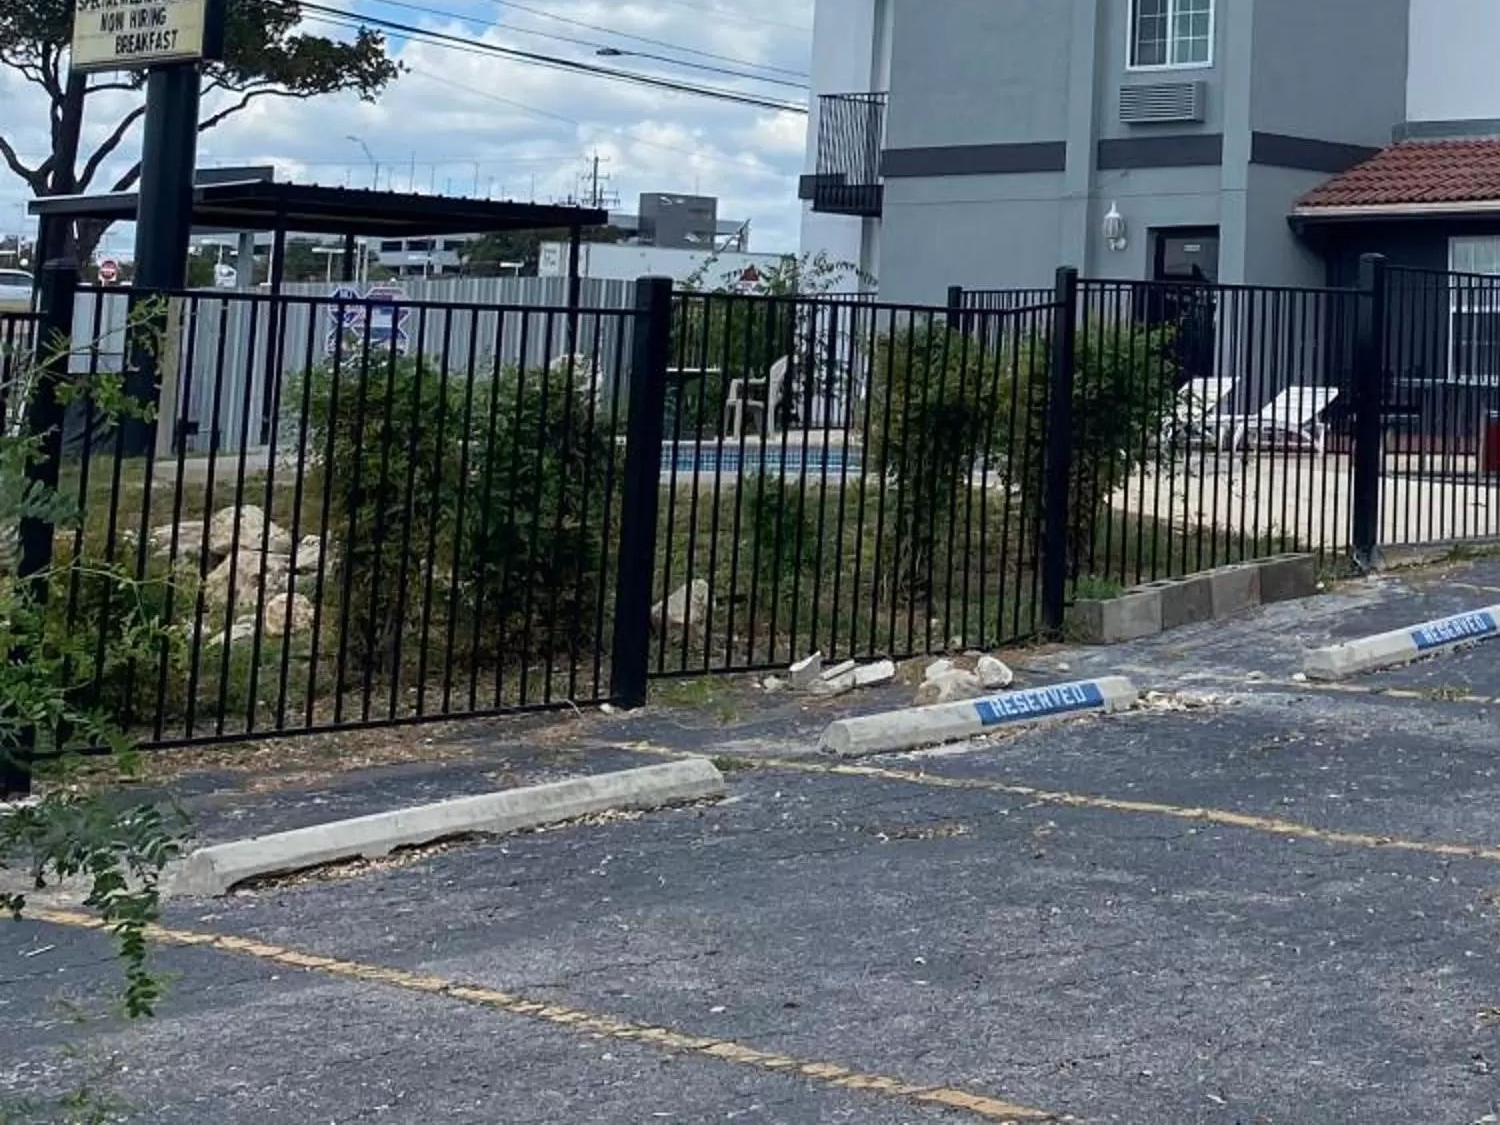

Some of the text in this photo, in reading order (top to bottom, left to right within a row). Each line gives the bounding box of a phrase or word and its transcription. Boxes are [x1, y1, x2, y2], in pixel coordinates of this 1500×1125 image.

[100, 6, 167, 32] NOW HIRING
[115, 30, 178, 54] BREAKFAST
[988, 684, 1088, 718] RESERVED
